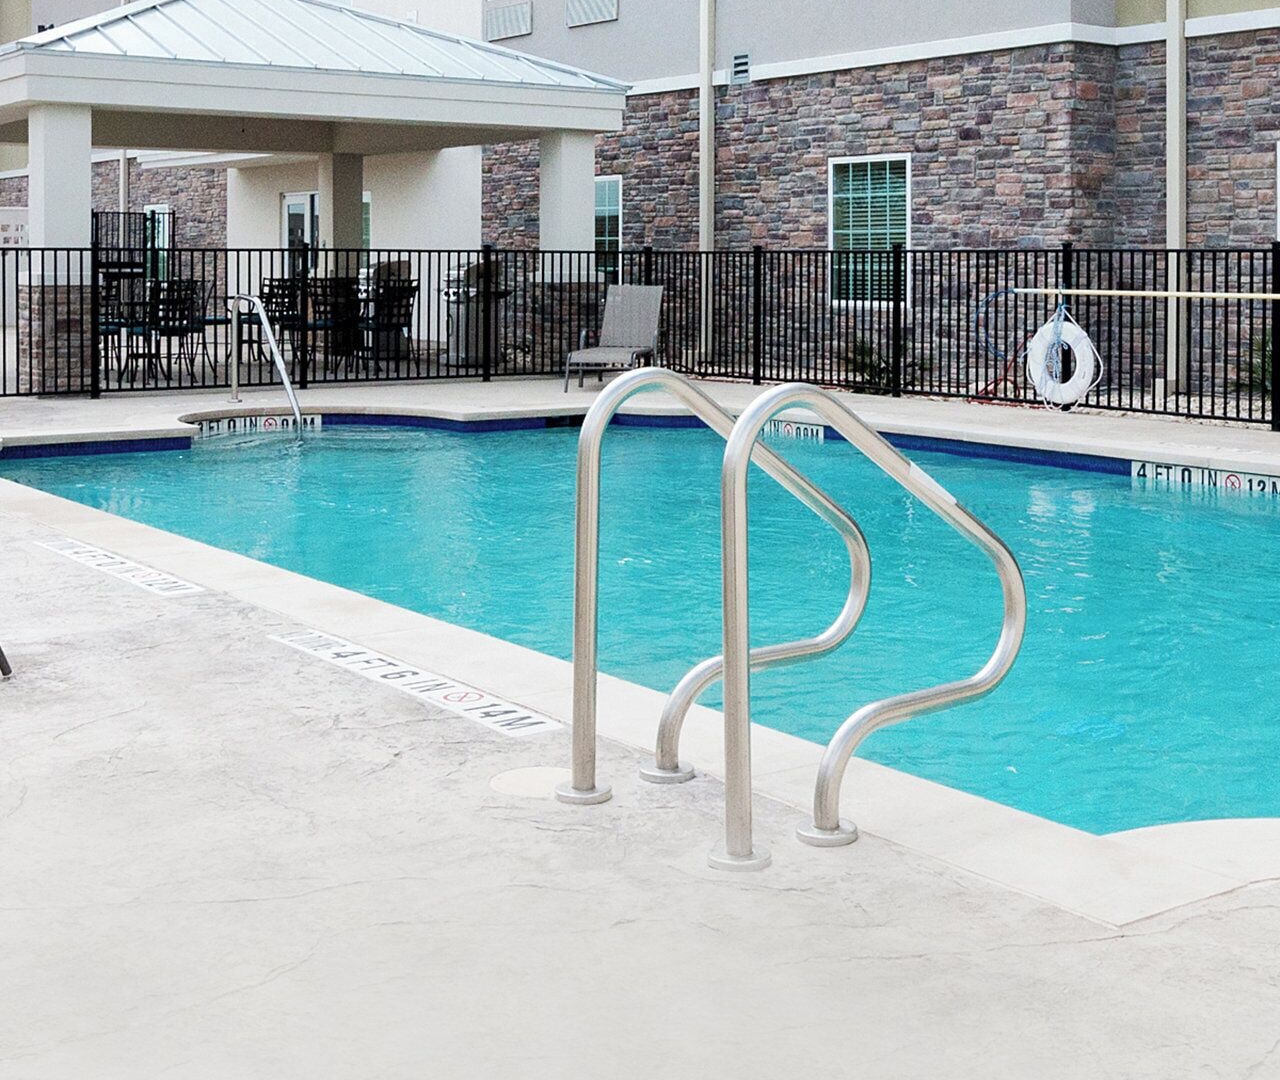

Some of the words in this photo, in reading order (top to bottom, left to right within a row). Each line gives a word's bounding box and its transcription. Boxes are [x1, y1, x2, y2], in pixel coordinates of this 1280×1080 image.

[1137, 463, 1147, 478] 4
[1155, 465, 1173, 481] FT
[1201, 469, 1217, 486] IN
[331, 650, 367, 660] 4
[346, 657, 399, 671] FT
[379, 670, 419, 680] 6
[402, 680, 455, 693] IN
